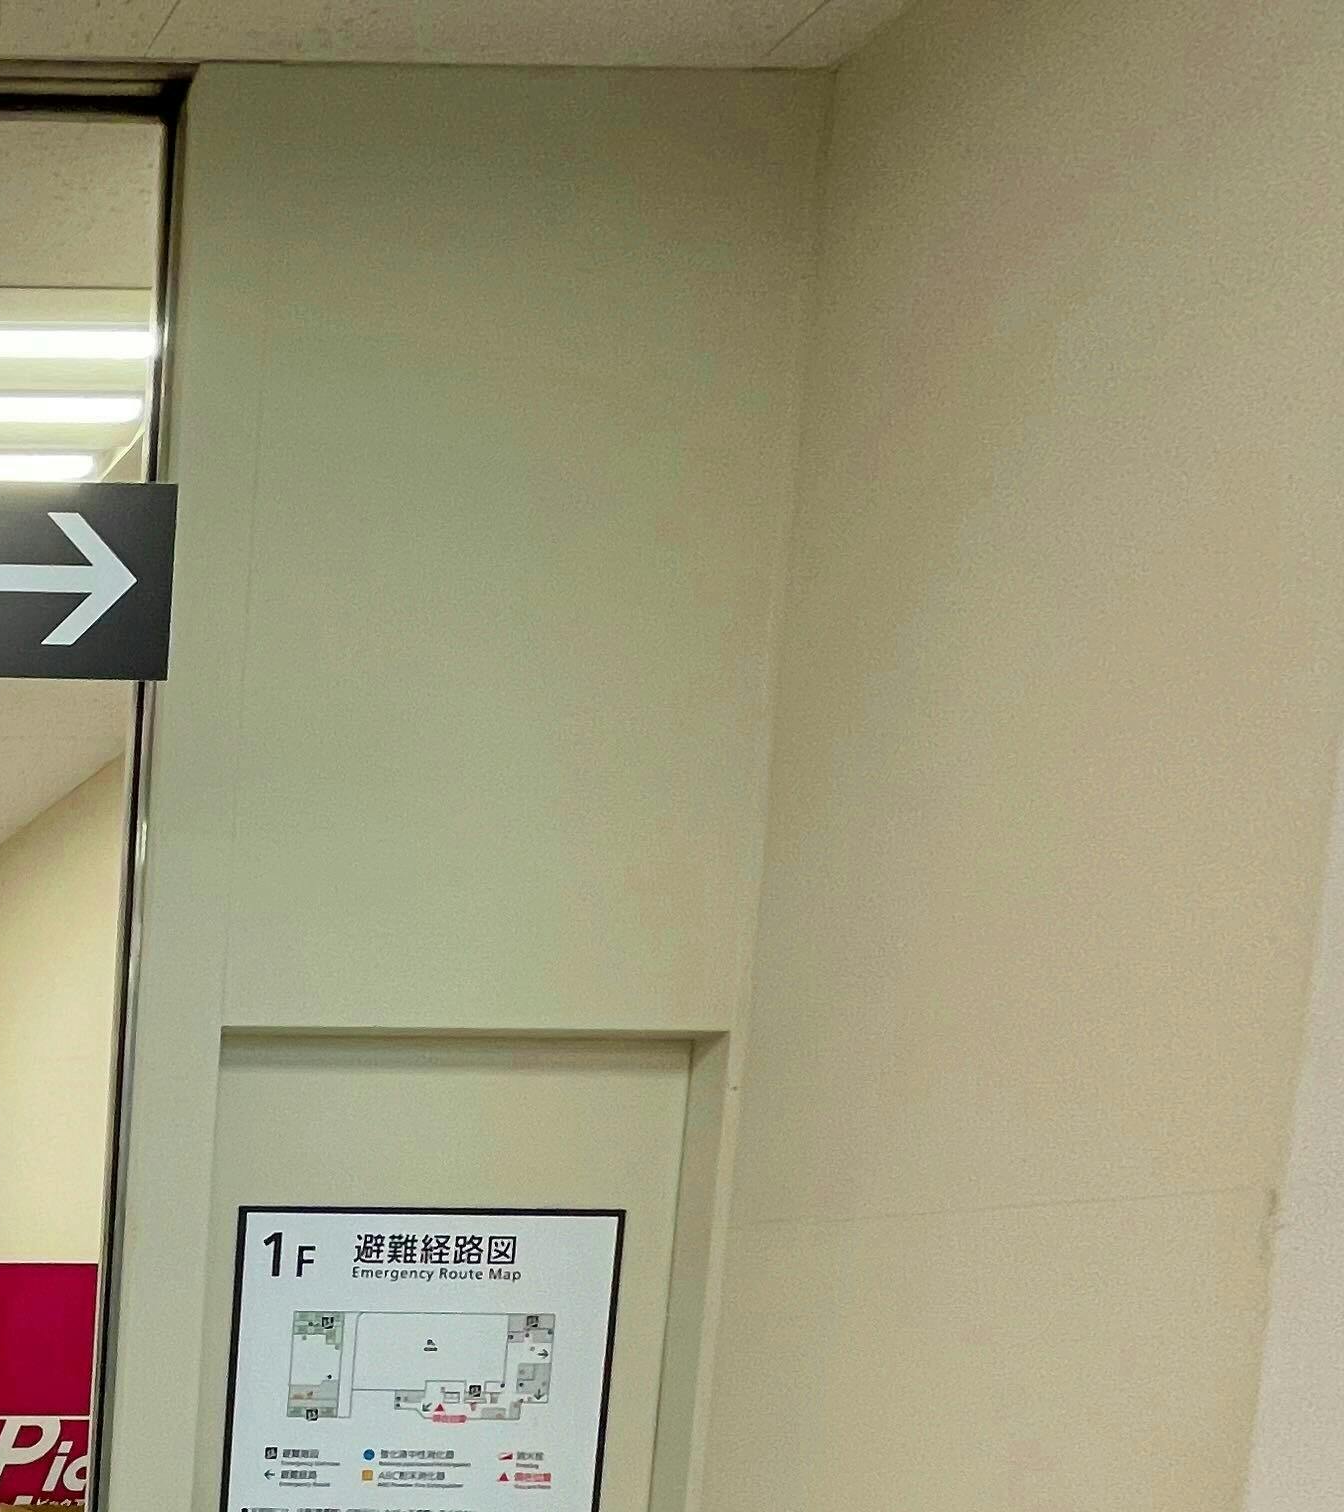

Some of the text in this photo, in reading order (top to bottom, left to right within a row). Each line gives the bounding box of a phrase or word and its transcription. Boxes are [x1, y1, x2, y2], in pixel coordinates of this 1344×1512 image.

[353, 1234, 516, 1264] 避難経路図
[352, 1266, 522, 1282] Emergency Route Map
